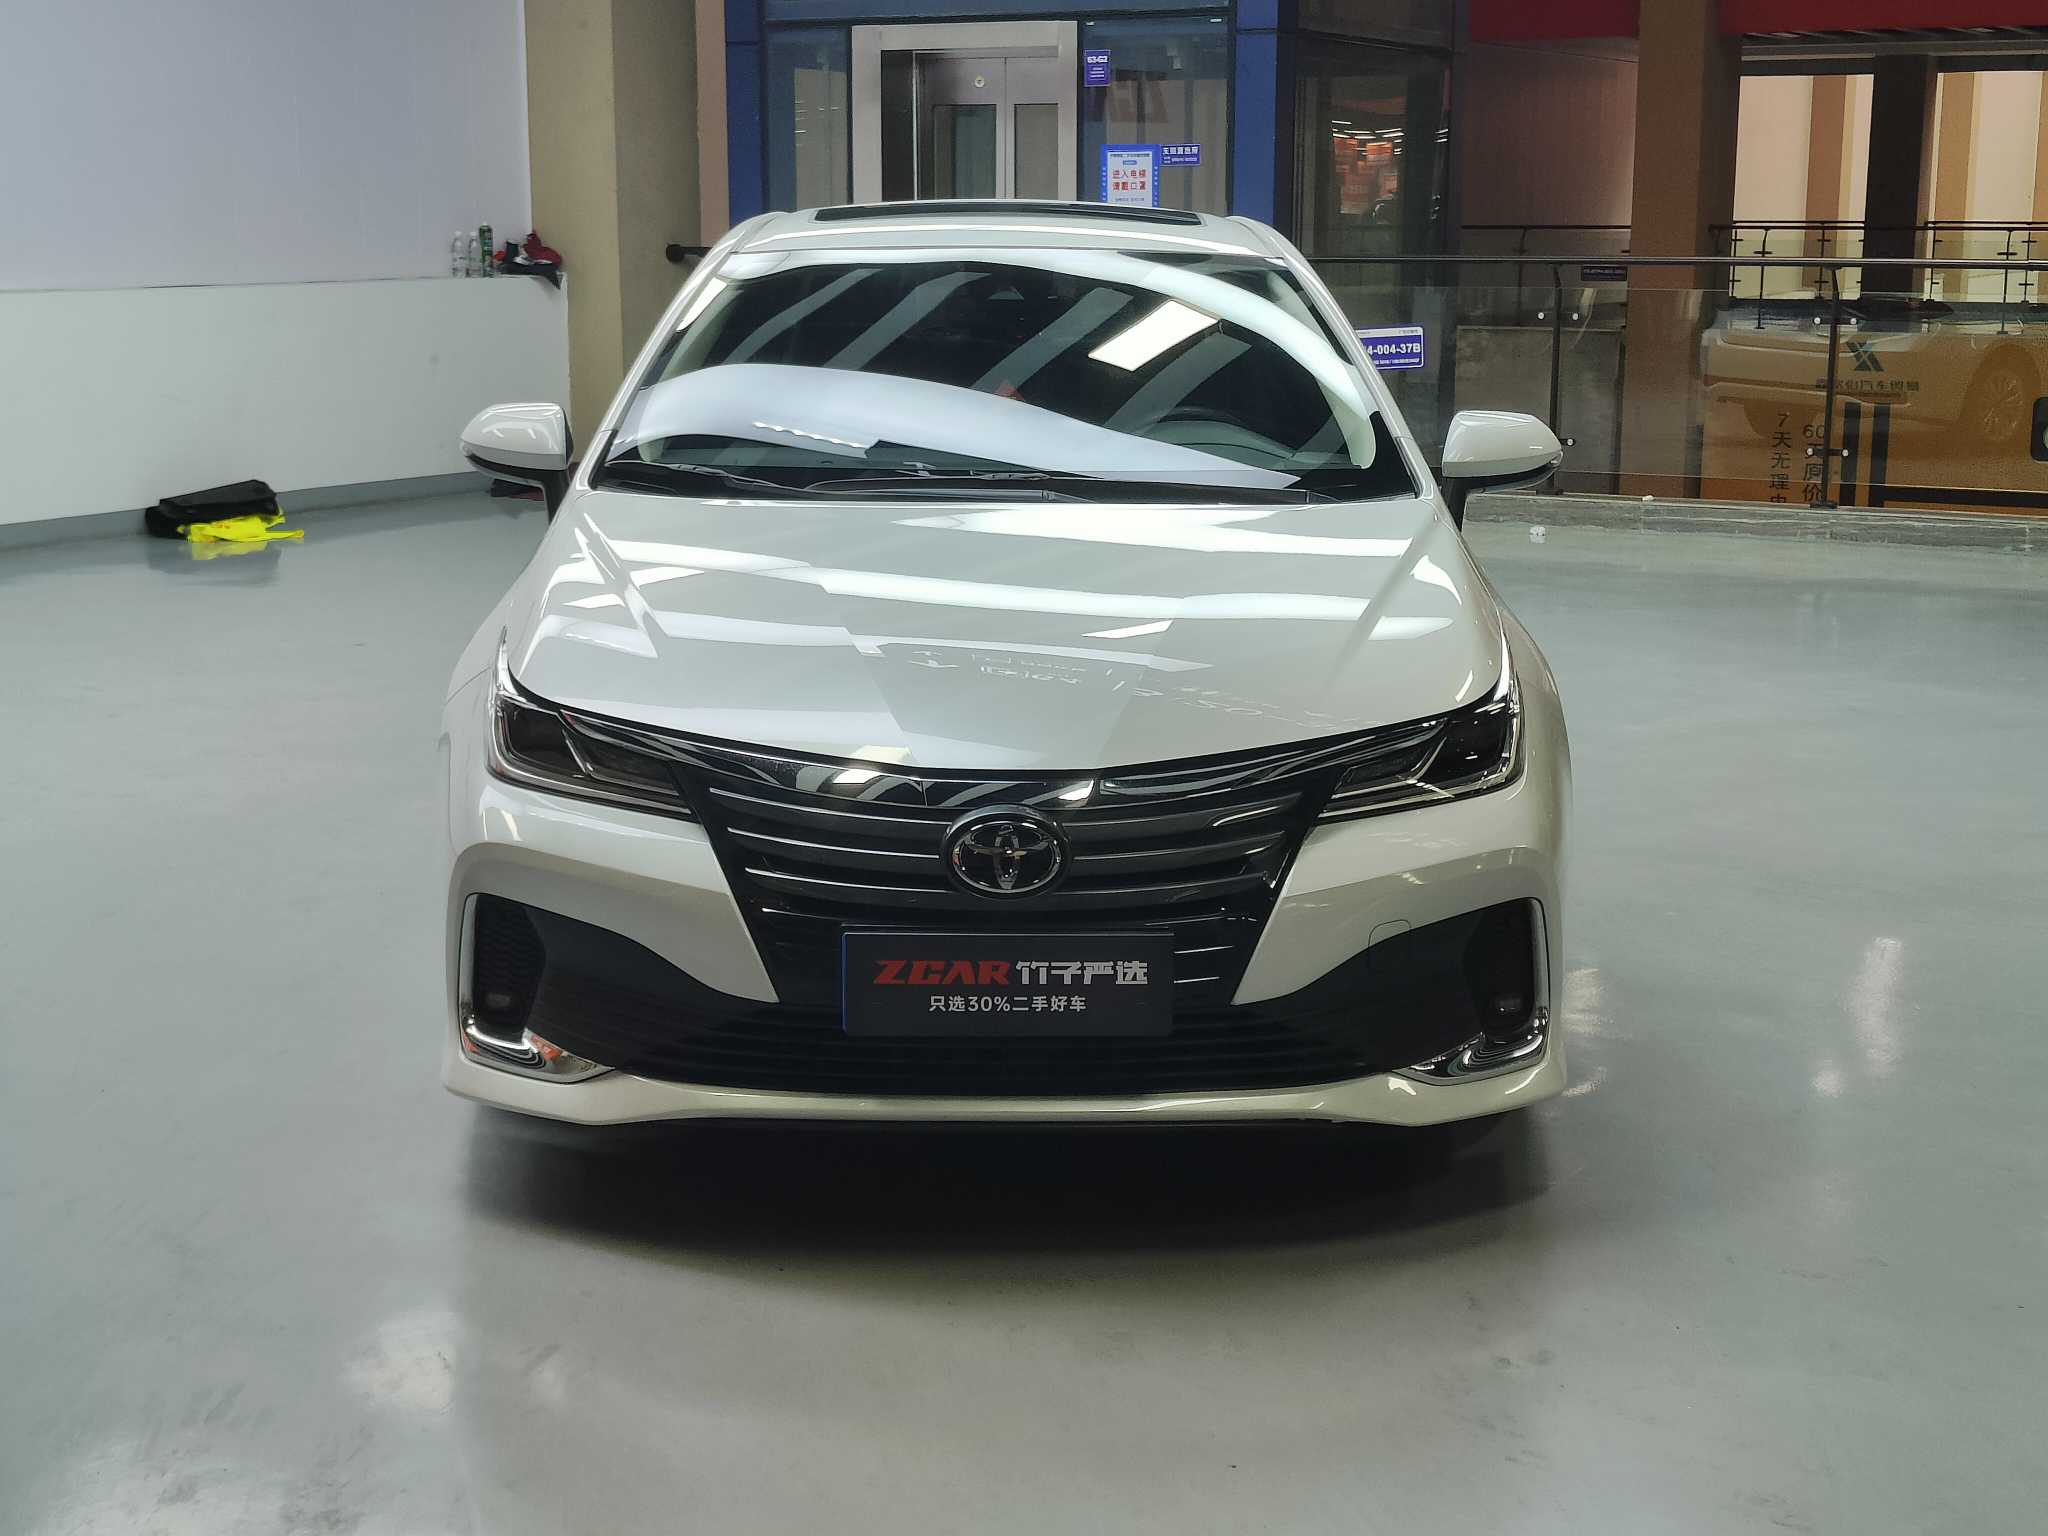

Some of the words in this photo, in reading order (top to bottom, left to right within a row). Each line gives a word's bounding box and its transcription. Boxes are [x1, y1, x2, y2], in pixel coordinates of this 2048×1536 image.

[1015, 960, 1149, 985] 竹子严选
[929, 995, 1087, 1012] 只选30%二手好车
